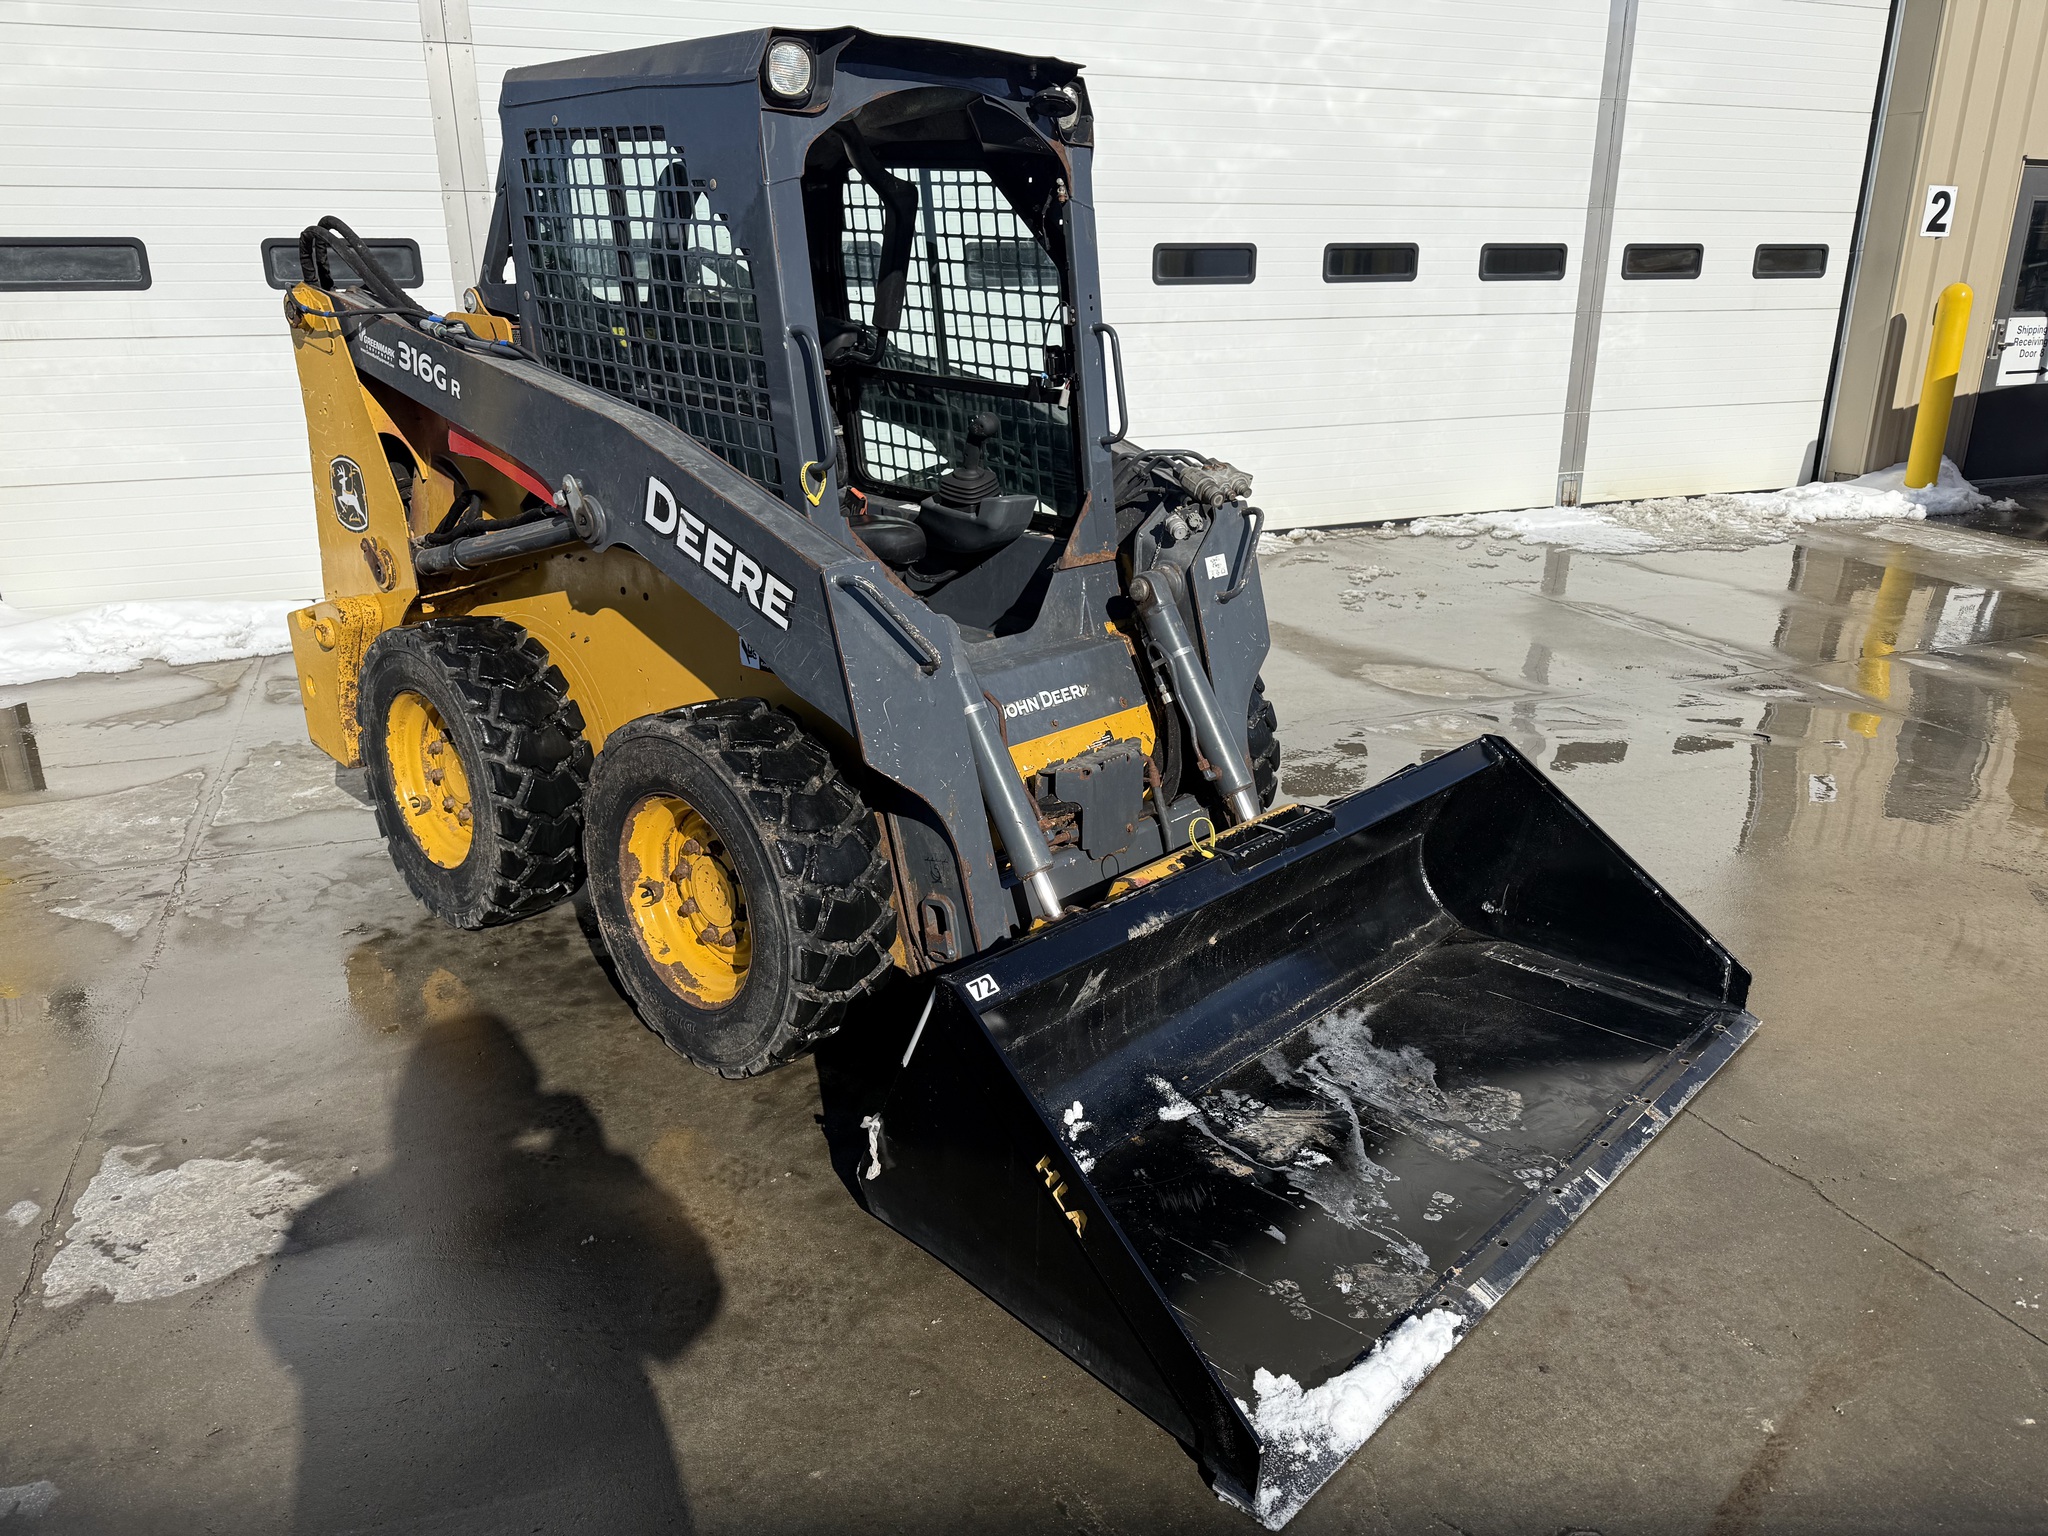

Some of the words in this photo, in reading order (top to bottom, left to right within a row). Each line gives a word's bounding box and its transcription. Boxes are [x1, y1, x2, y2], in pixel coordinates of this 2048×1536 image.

[1926, 190, 1951, 232] 2
[2016, 324, 2048, 336] Shipping
[363, 335, 396, 359] GREENMARK
[2013, 337, 2048, 348] Receiving
[2019, 349, 2037, 358] Door
[398, 341, 447, 391] 316G
[451, 378, 461, 400] R
[645, 476, 794, 631] DEERE
[970, 977, 997, 998] 72
[1036, 1154, 1088, 1239] HLA
